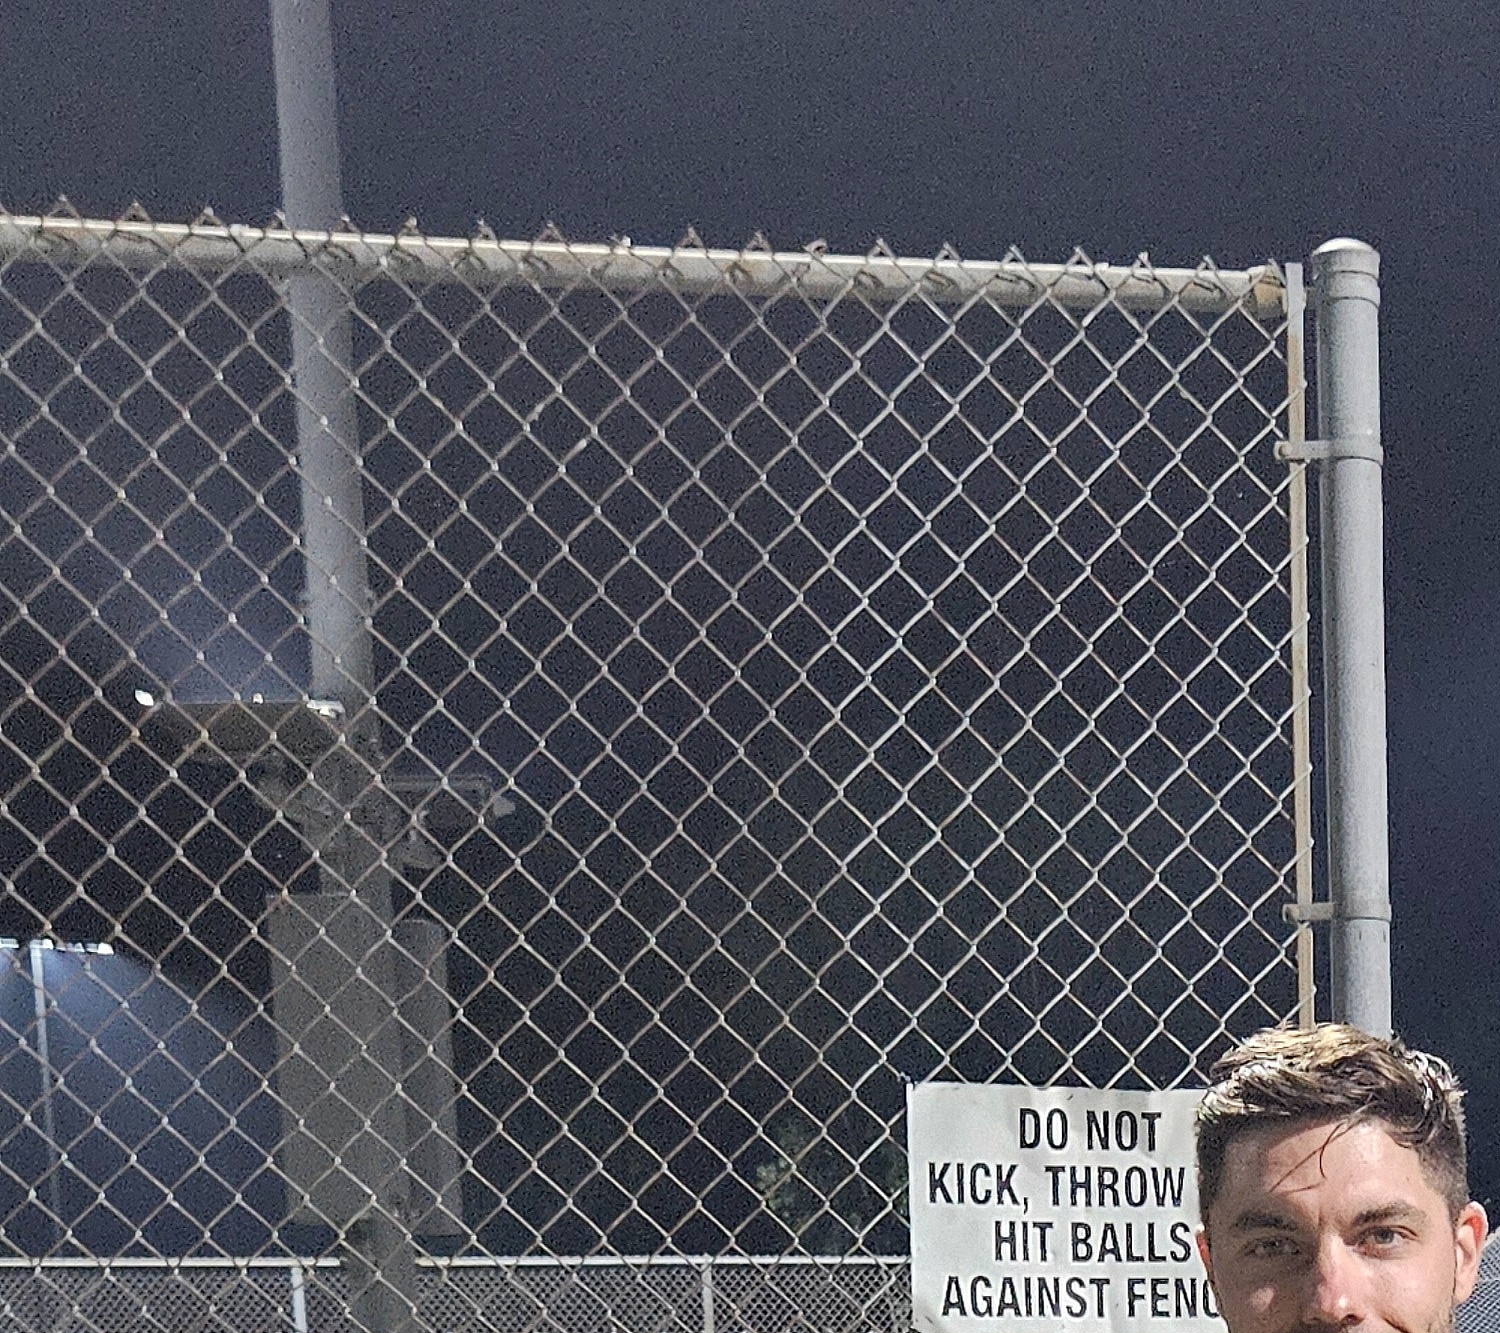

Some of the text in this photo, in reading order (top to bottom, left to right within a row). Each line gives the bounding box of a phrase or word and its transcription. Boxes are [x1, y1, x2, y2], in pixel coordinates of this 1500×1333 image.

[1018, 1107, 1162, 1152] DO NOT
[928, 1161, 1186, 1214] KICK, THROW
[994, 1220, 1192, 1263] HIT BALLS
[941, 1275, 1111, 1318] AGAINST
